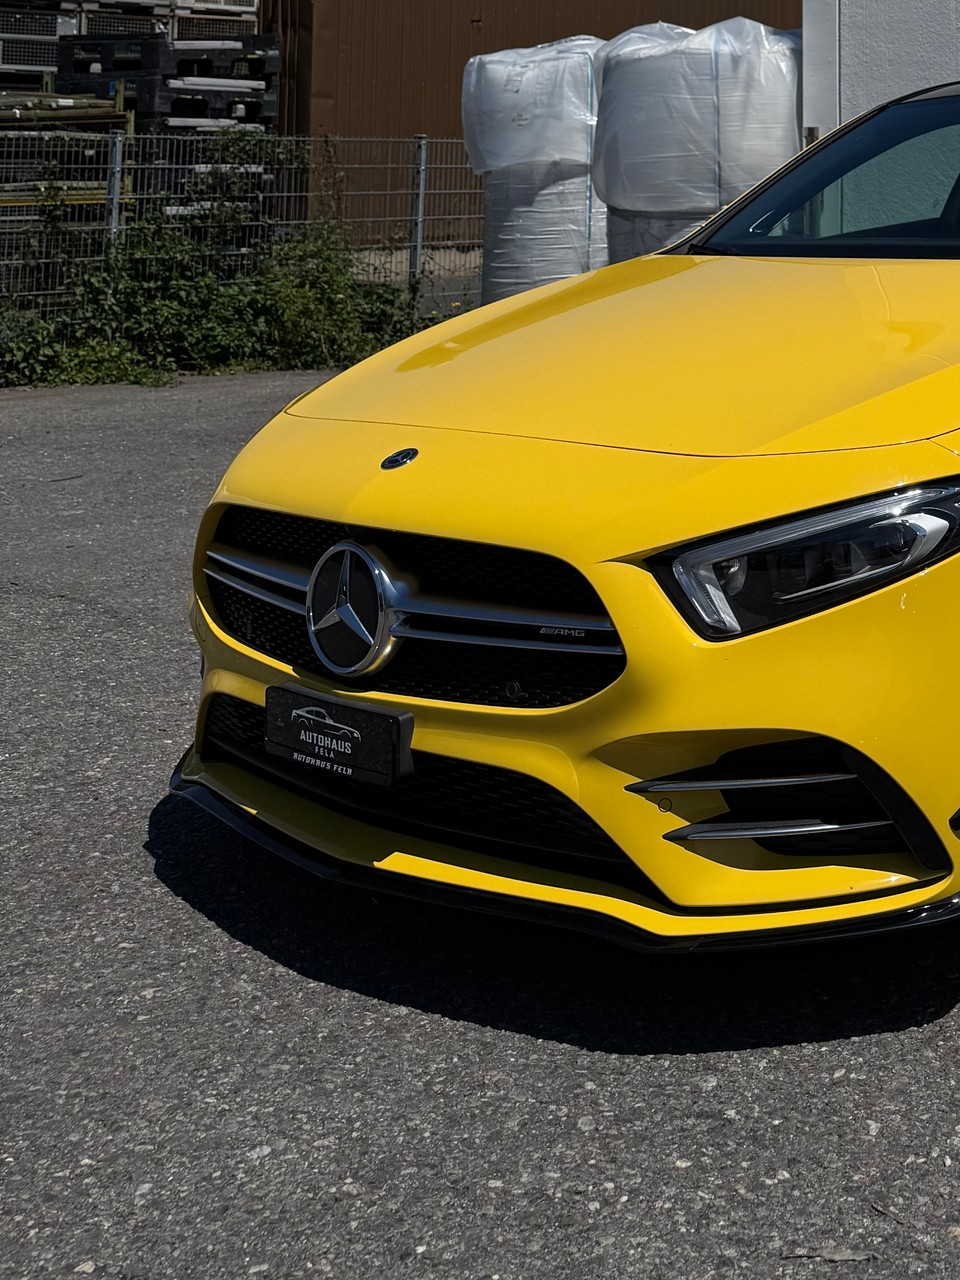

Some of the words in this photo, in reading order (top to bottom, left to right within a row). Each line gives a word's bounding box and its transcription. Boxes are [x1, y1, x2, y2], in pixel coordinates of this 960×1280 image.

[551, 628, 585, 637] AMG
[300, 729, 352, 754] AUTOHAUS
[315, 746, 335, 758] FELA
[293, 752, 331, 769] AUTOHAUS
[333, 764, 353, 776] FELA
